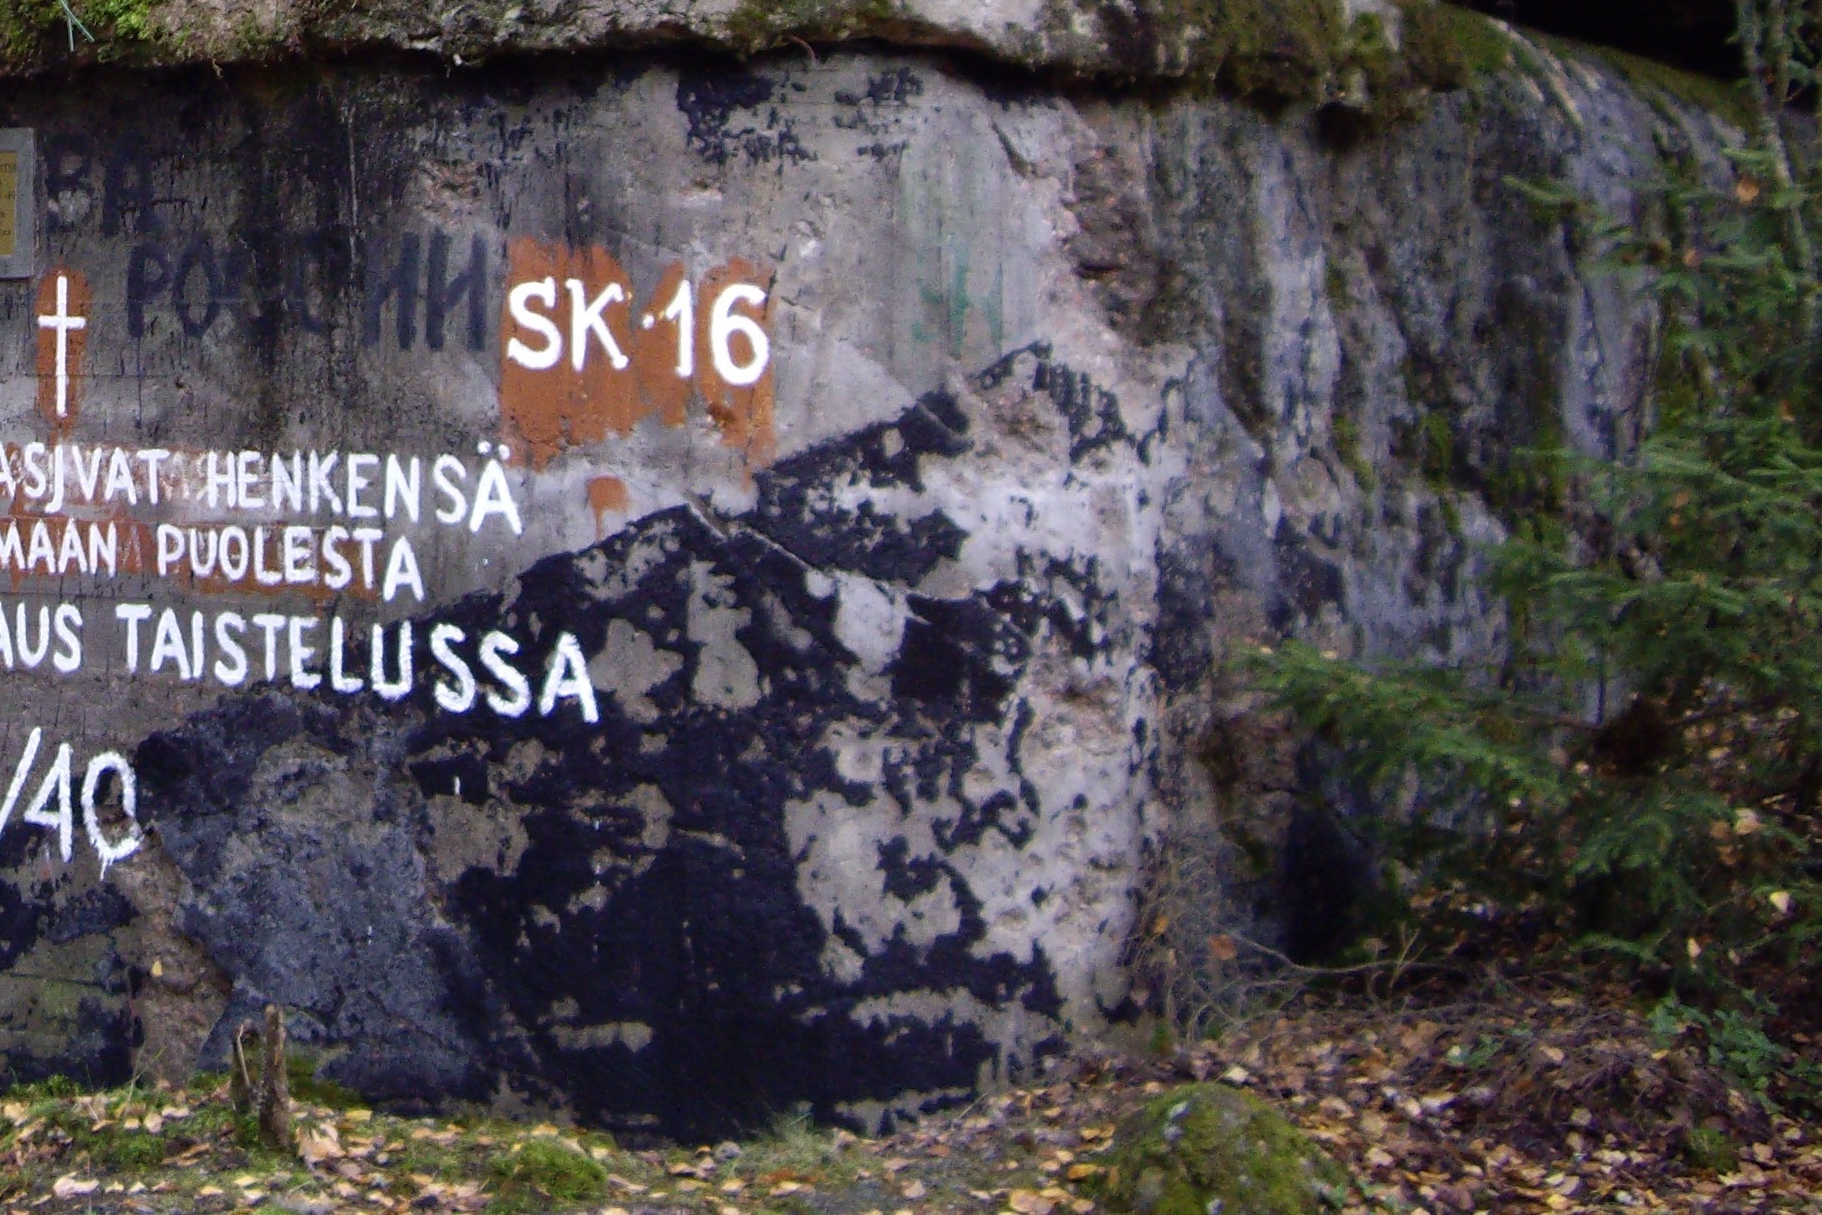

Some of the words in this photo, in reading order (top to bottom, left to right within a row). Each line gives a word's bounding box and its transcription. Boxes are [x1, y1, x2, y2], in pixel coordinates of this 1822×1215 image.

[205, 442, 521, 534] HENKENSÄ
[156, 525, 425, 601] PUOLESTA
[115, 604, 599, 723] TAISTELUSSA
